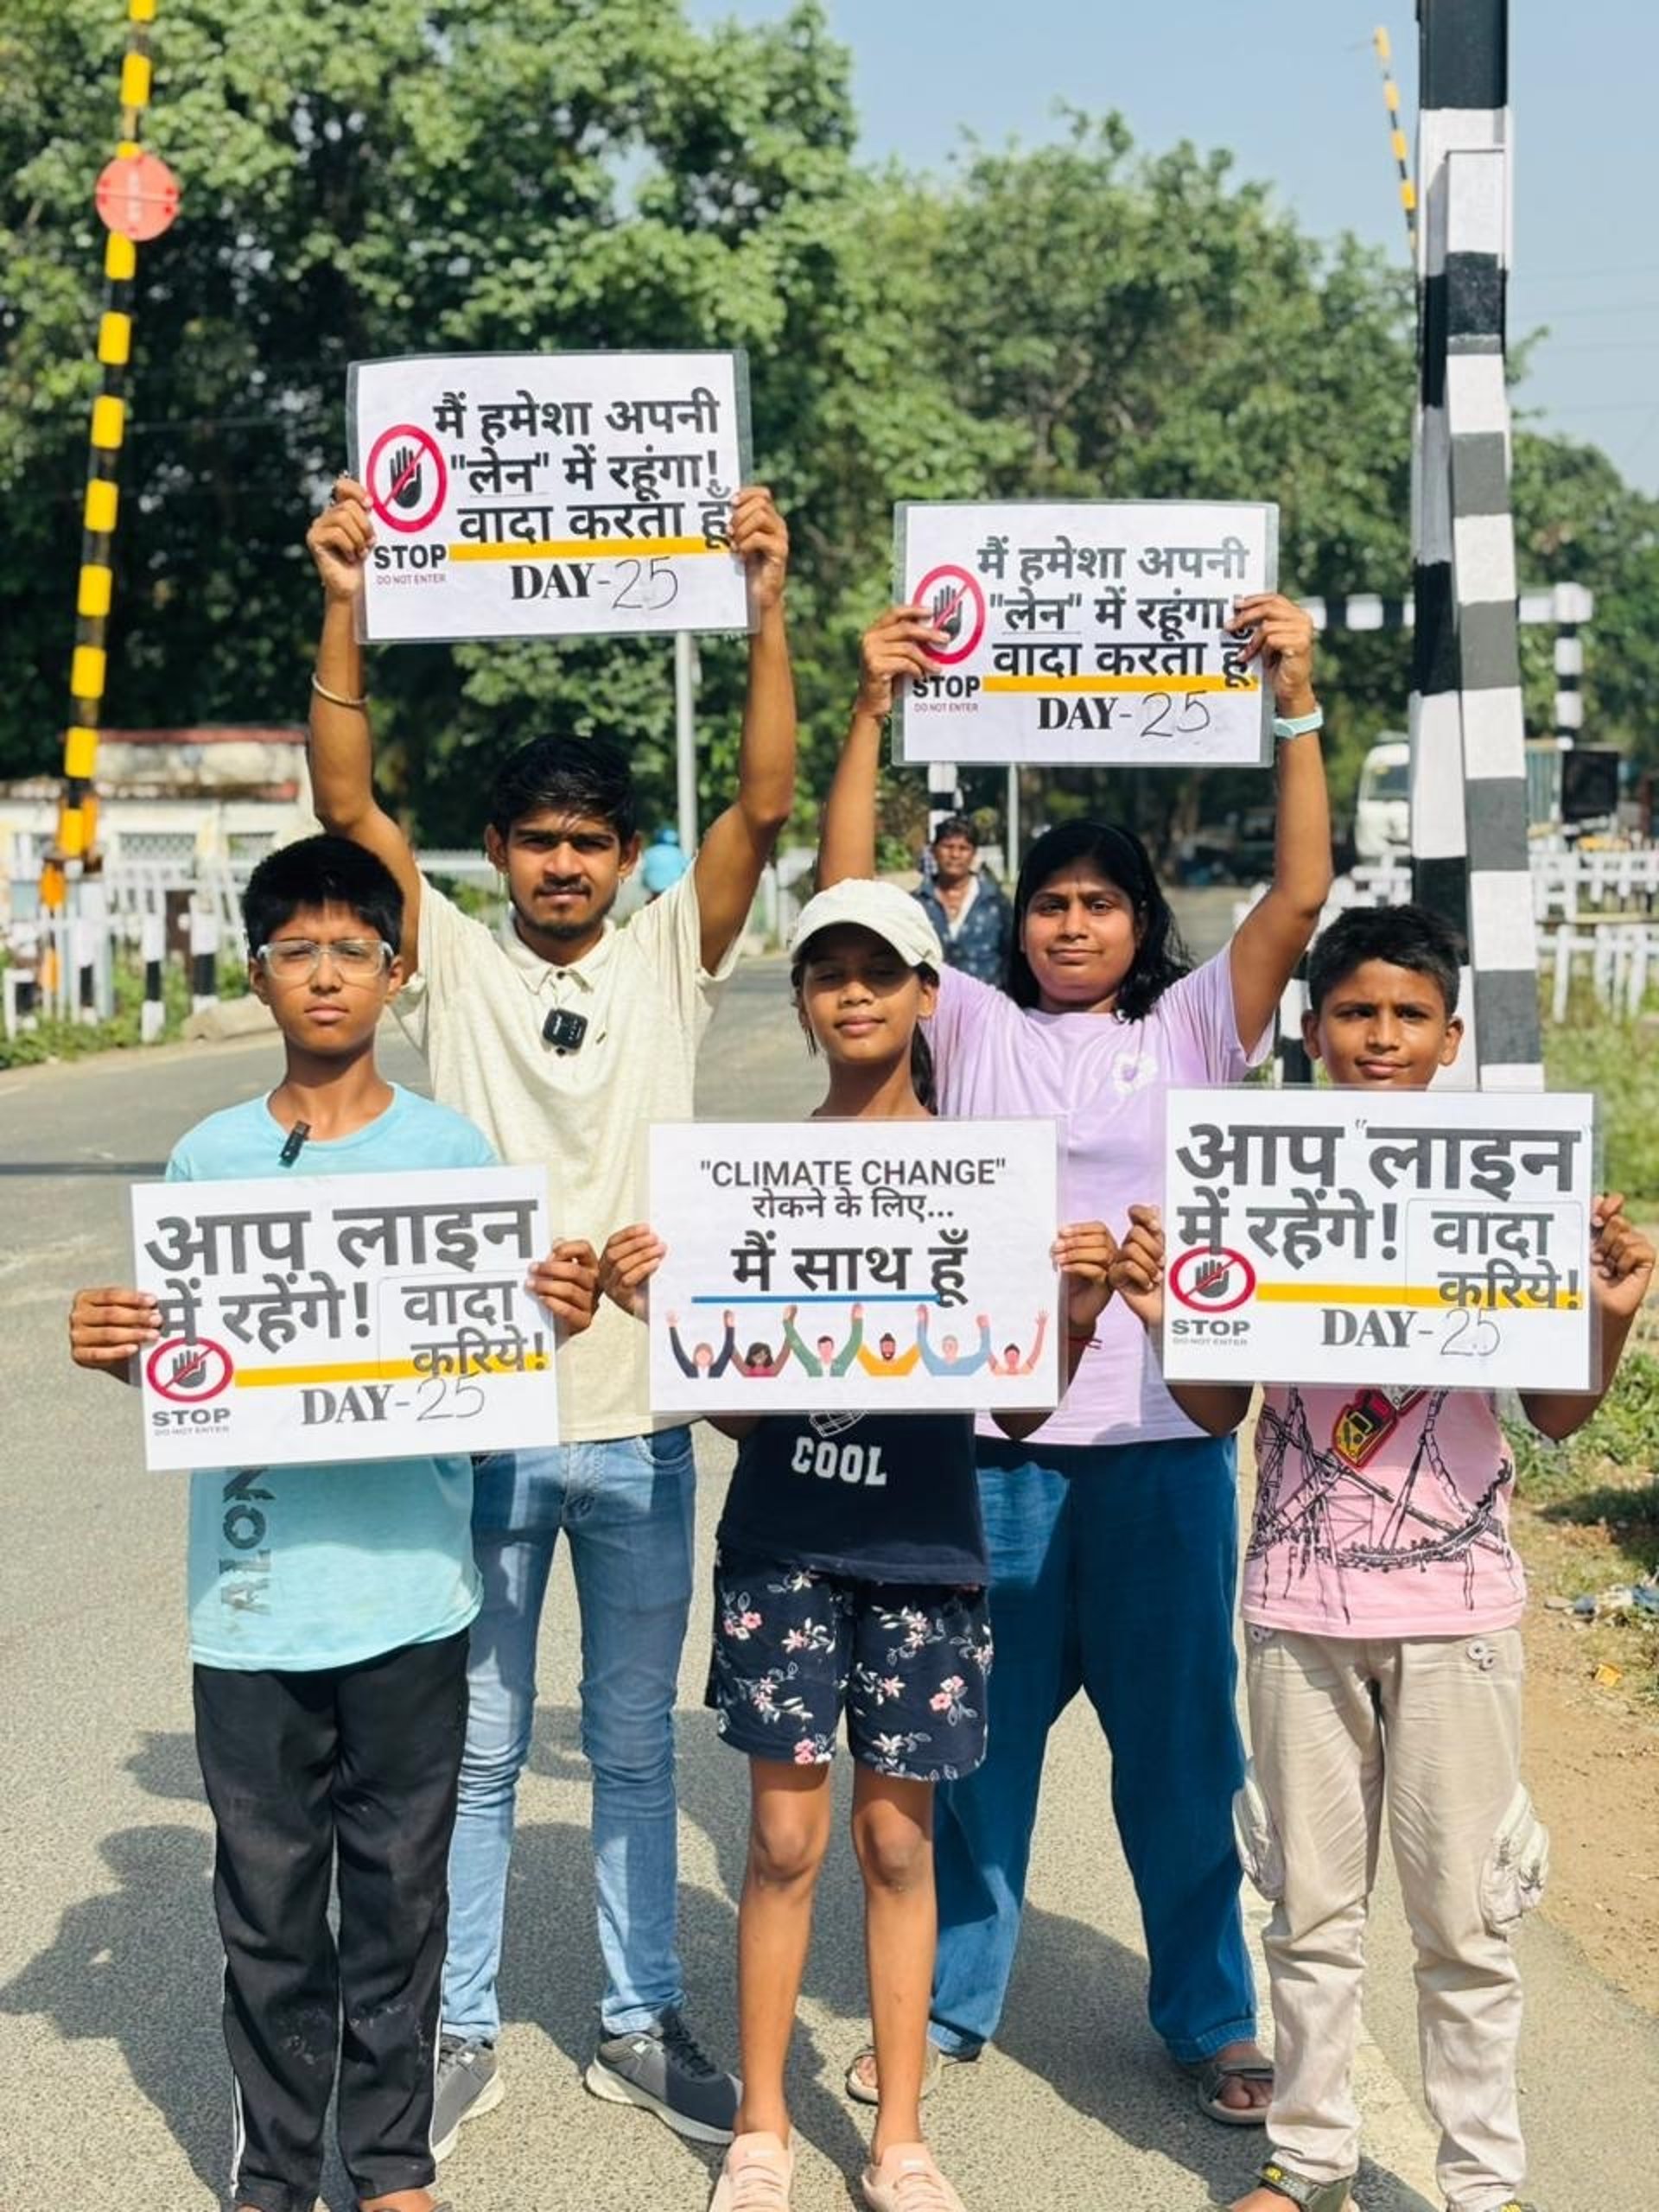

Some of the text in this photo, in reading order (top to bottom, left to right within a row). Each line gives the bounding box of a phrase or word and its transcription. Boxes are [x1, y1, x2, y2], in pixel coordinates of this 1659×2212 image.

[432, 385, 721, 446] मैं हमेशा अपनी
[449, 445, 550, 494] "लेन"
[563, 443, 596, 490] में
[456, 477, 733, 550] वादा करता हूँ
[373, 543, 447, 570] STOP
[375, 574, 391, 585] DO
[392, 574, 412, 585] NOT
[976, 534, 1250, 588] मैं हमेशा अपनी
[989, 586, 1083, 632] "लेन"
[1094, 586, 1128, 631] में
[992, 641, 1083, 678] वादा
[1095, 641, 1208, 677] करता
[912, 675, 981, 698] STOP
[700, 1158, 1007, 1187] "CLIMATE CHANGE"
[1175, 1119, 1345, 1187] आप
[752, 1187, 826, 1219] रोकने
[835, 1187, 862, 1218] के
[1177, 1187, 1555, 1270] में रहेंगे! वादा
[143, 1198, 539, 1276] आप लाइन
[731, 1229, 969, 1308] मैं साथ हूँ
[1437, 1258, 1580, 1311] करिये!
[161, 1270, 518, 1354] में रहेंगे! वादा
[1171, 1319, 1251, 1337] STOP
[410, 1324, 548, 1378] करिये!
[152, 1408, 231, 1427] STOP
[791, 1436, 887, 1486] COOL
